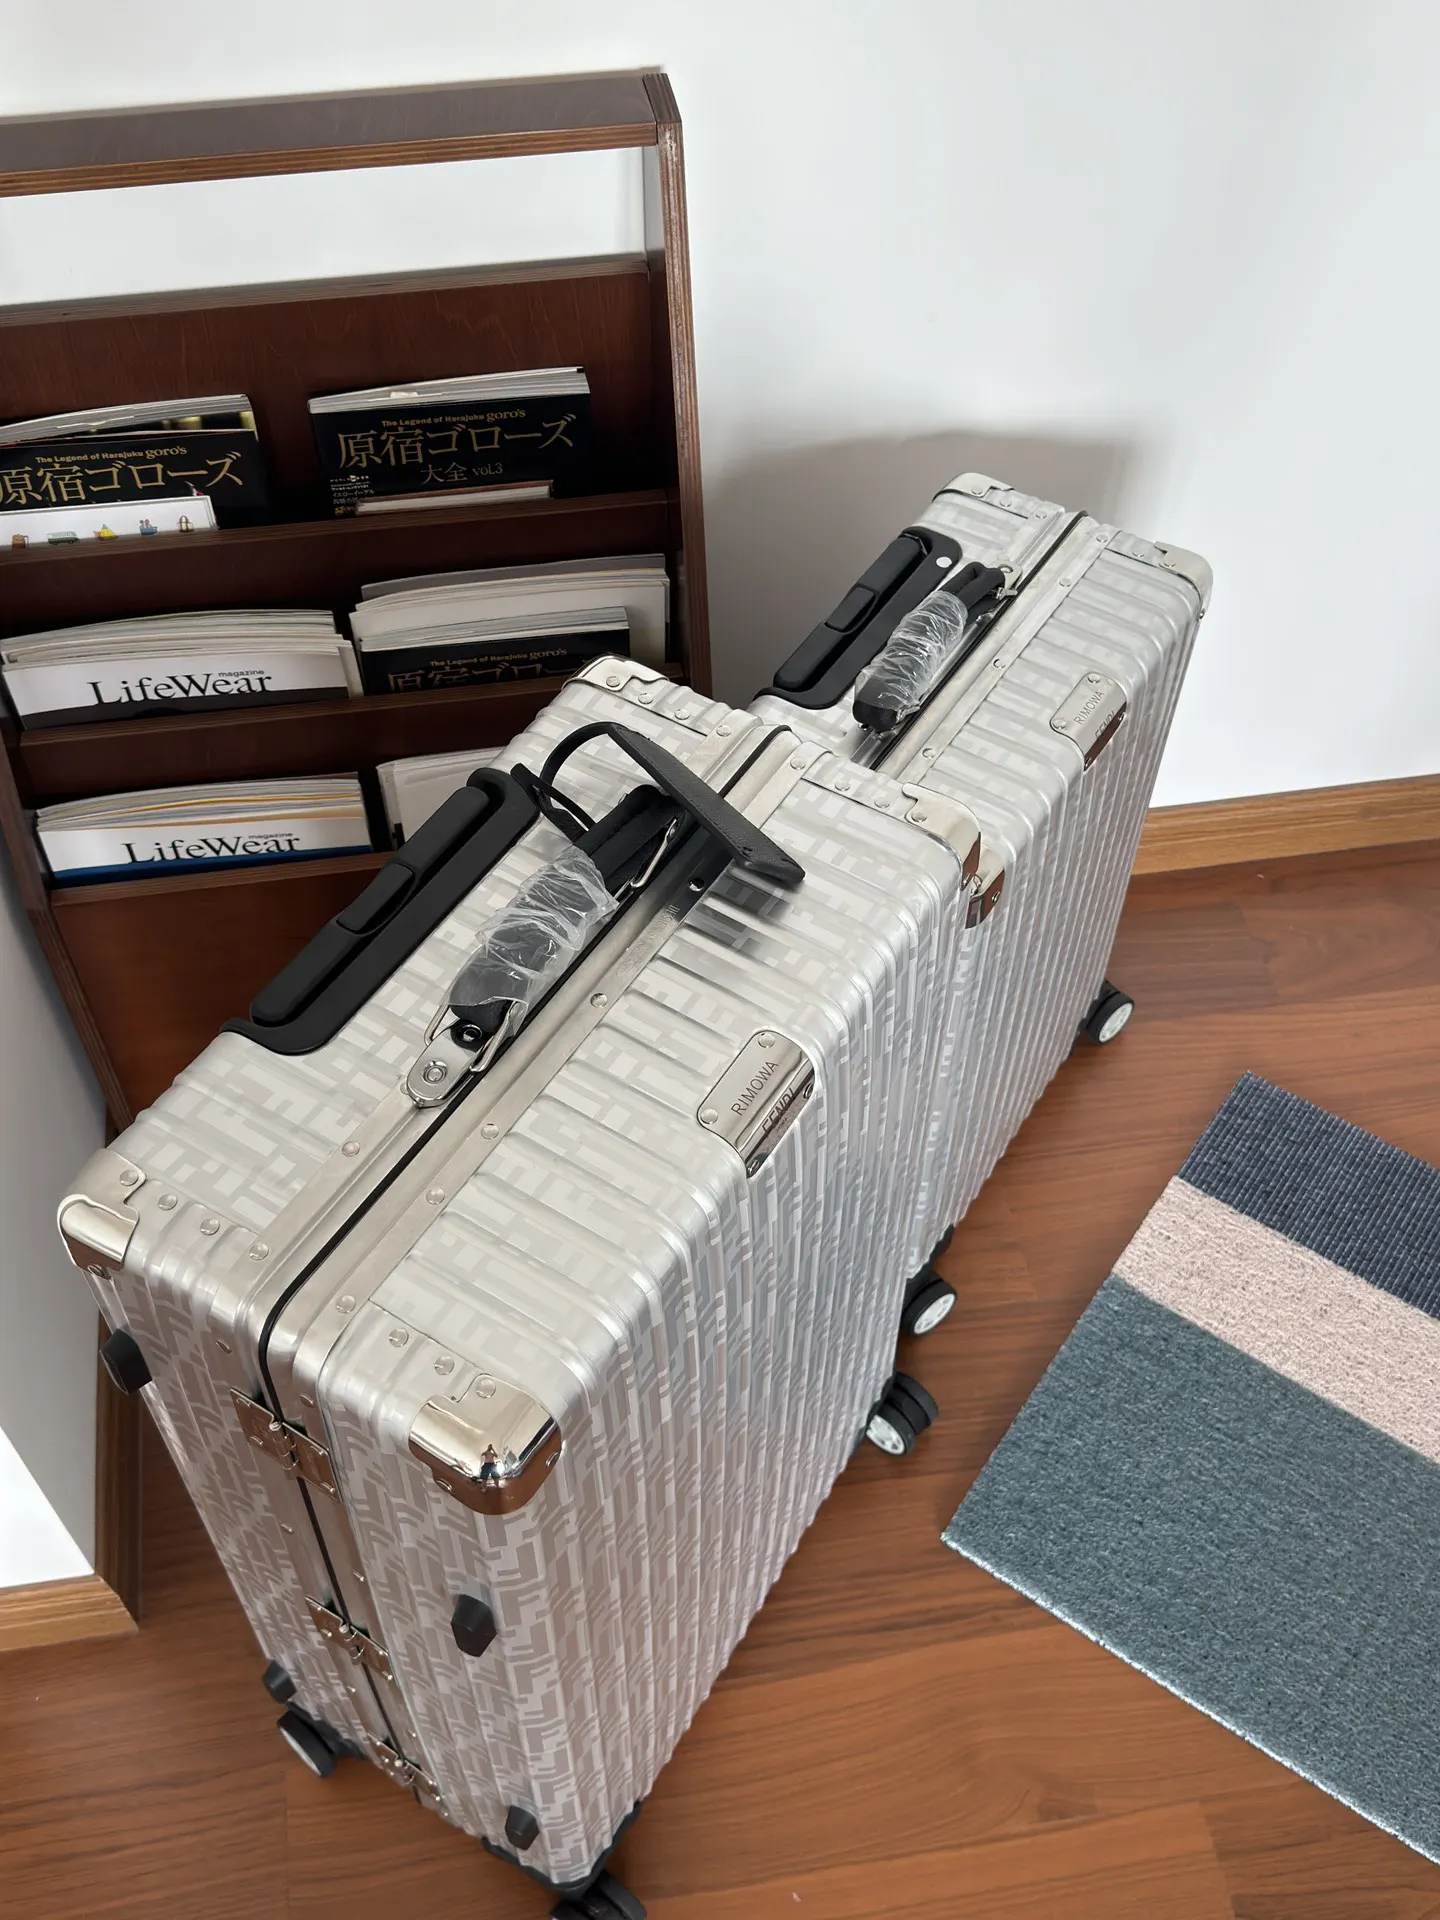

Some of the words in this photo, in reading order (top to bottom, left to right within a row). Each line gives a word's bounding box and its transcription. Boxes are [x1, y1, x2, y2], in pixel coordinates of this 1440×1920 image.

[433, 415, 443, 424] of
[486, 408, 527, 423] goro's
[35, 456, 52, 464] The
[54, 453, 89, 463] Legend
[90, 451, 100, 461] of
[101, 450, 144, 462] Harajuku
[144, 445, 188, 461] goro's
[336, 412, 577, 469] 原宿ゴローズ
[0, 451, 244, 505] 原宿ゴローズ
[420, 461, 469, 486] 大全
[472, 462, 504, 478] vol.3
[87, 672, 273, 706] LifeWear
[217, 669, 265, 679] magazine
[1073, 690, 1105, 725] RIMOWA
[121, 834, 301, 865] LifeWear
[247, 831, 294, 841] magazine
[730, 1060, 779, 1116] RIMOWA
